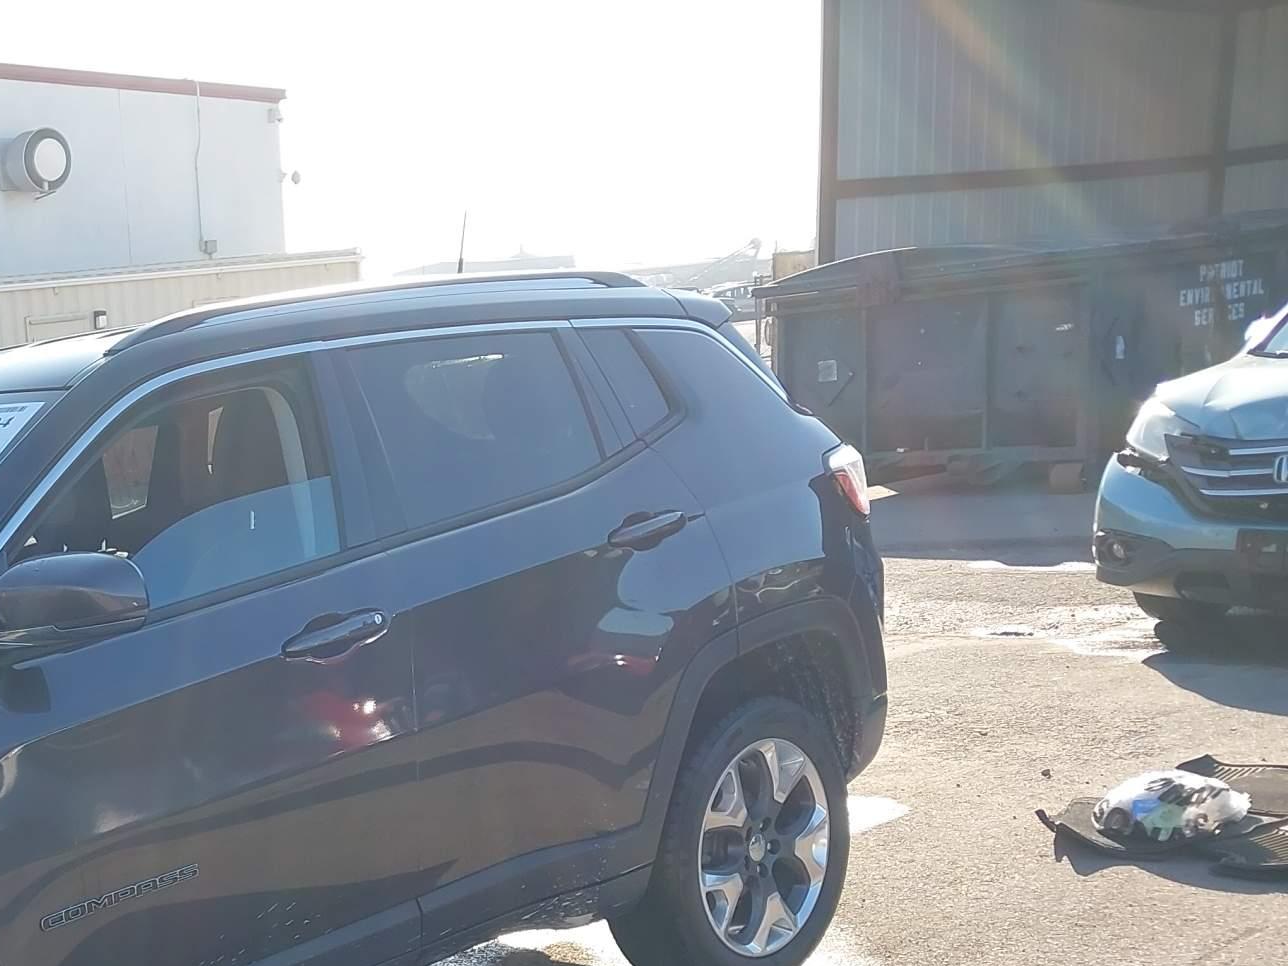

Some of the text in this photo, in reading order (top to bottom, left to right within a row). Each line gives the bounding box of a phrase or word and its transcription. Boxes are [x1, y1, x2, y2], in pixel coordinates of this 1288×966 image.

[1200, 260, 1244, 282] PATRIOT
[1179, 279, 1264, 307] ENVIRMENTAL
[1194, 303, 1245, 326] SERES
[40, 863, 200, 931] COMPASS
